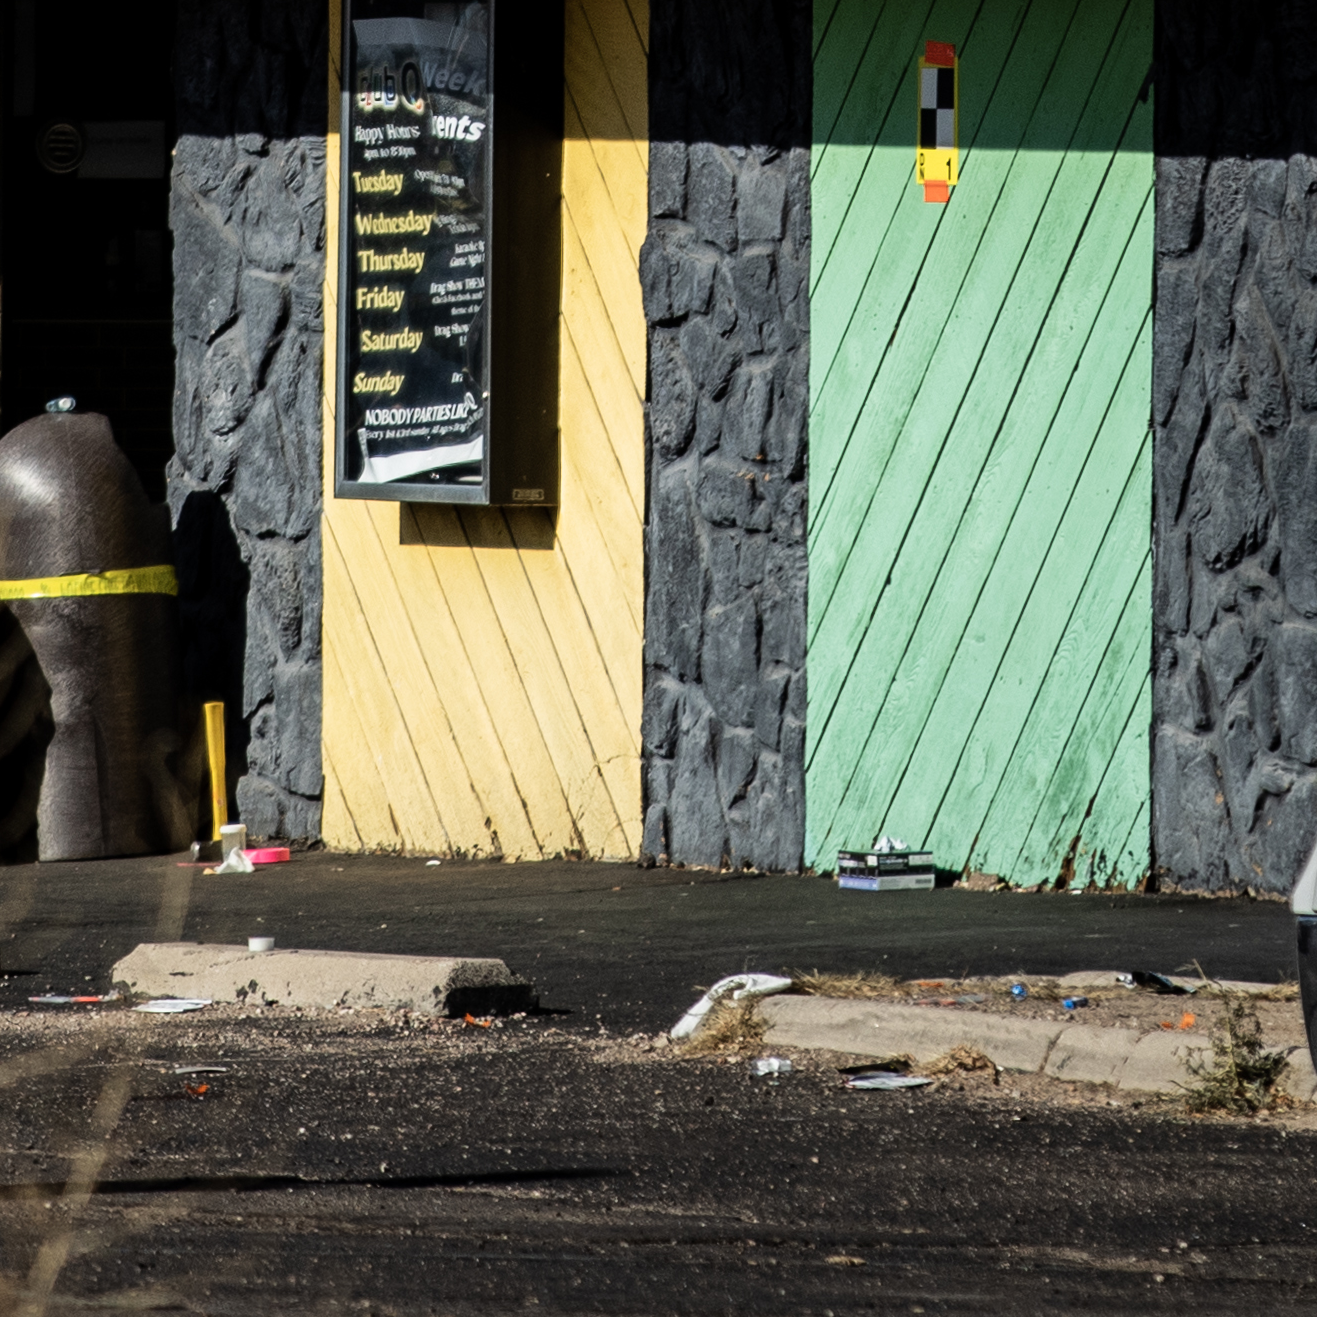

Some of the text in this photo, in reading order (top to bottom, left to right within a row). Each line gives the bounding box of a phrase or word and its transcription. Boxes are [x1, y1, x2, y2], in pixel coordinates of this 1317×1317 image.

[354, 123, 421, 145] Happy Hours
[352, 168, 404, 196] Tuesday
[354, 210, 433, 236] Wednesday
[357, 247, 426, 274] Thursday
[355, 285, 405, 313] Friday
[360, 326, 423, 354] Saturday
[353, 370, 405, 396] Sunday
[365, 407, 414, 426] NOBODY
[413, 404, 452, 423] PARTIES
